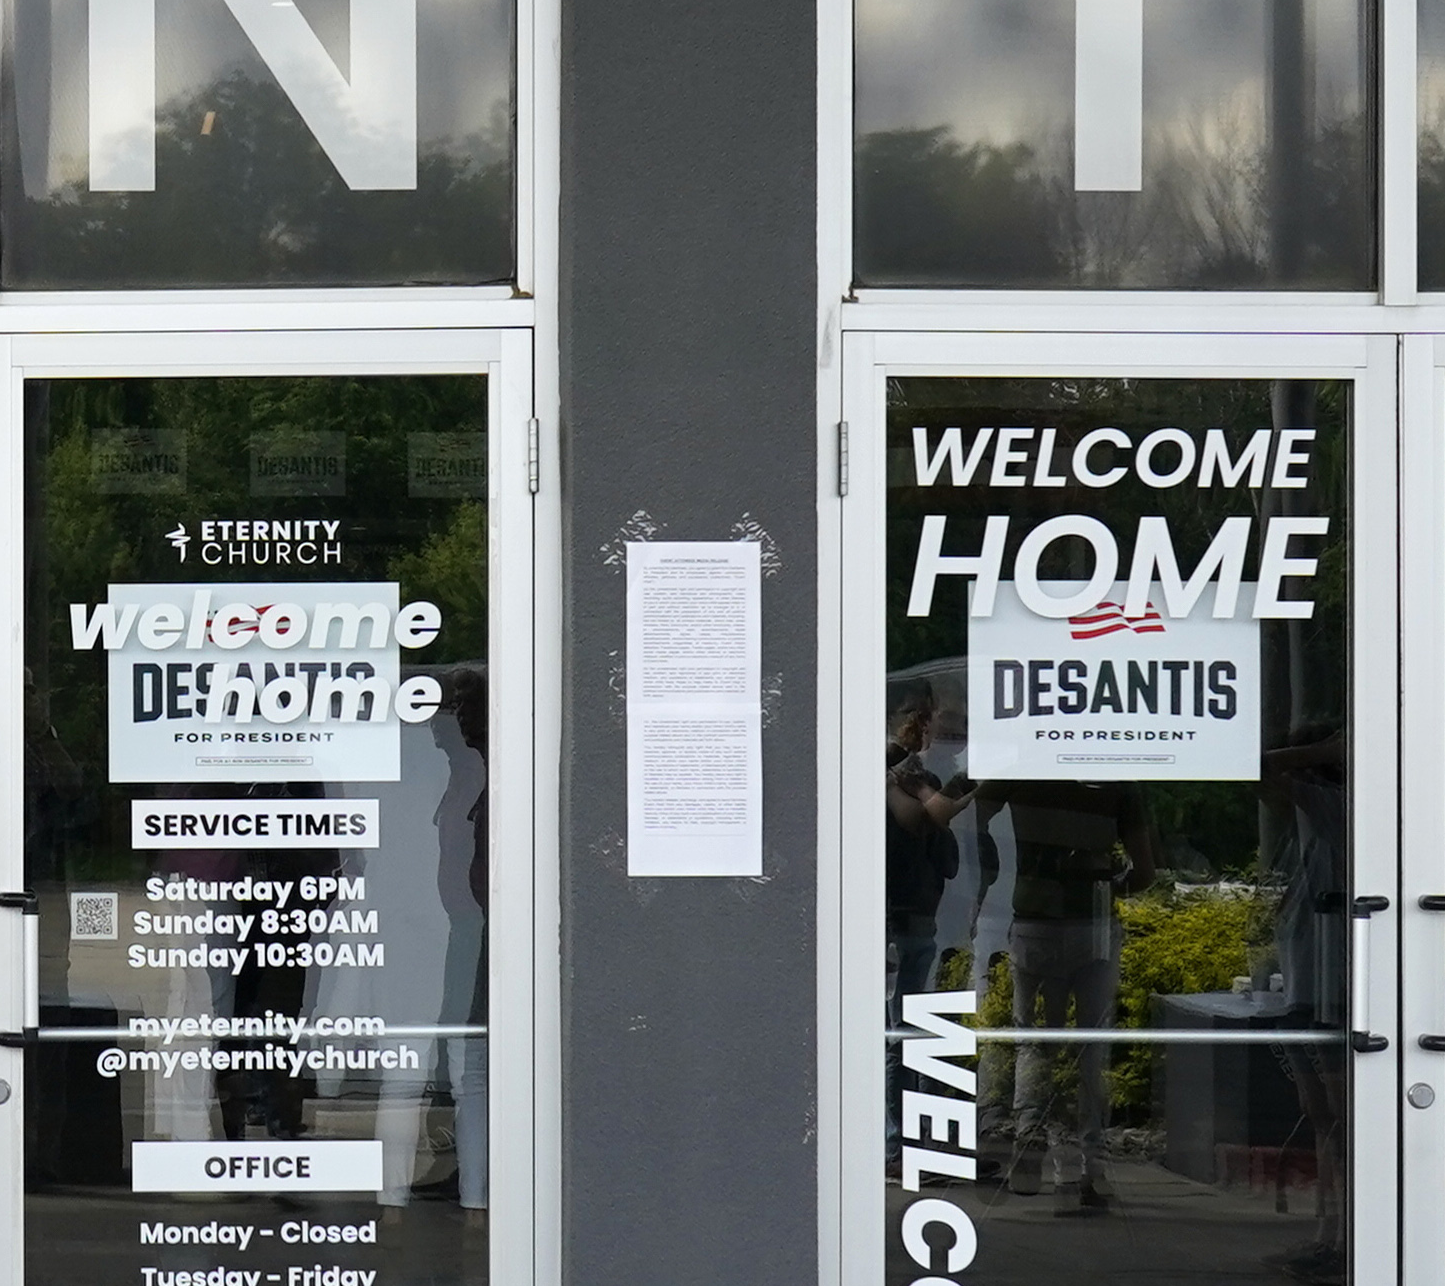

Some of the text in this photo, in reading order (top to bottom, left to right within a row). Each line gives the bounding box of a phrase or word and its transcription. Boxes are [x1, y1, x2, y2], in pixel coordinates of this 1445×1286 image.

[911, 427, 1317, 489] WELCOME
[201, 520, 341, 541] ETERNITY
[201, 542, 342, 565] CHURCH
[906, 514, 1330, 620] HOME
[68, 588, 443, 651] welcome
[204, 662, 443, 725] home
[993, 659, 1238, 720] DESANTIS
[174, 732, 335, 743] FOR PRESIDENT
[1035, 730, 1197, 741] FOR PRESIDENT
[144, 813, 367, 837] SERVICE TIMES
[145, 876, 366, 908] Saturday 6PM
[133, 909, 379, 942] Sunday 8:30AM
[127, 942, 385, 975] Sunday 10:30AM
[128, 1010, 386, 1044] myeternity.com
[96, 1043, 420, 1078] @myeternitychurch
[204, 1156, 311, 1179] OFFICE
[140, 1222, 254, 1250] Monday
[280, 1221, 377, 1244] Closed
